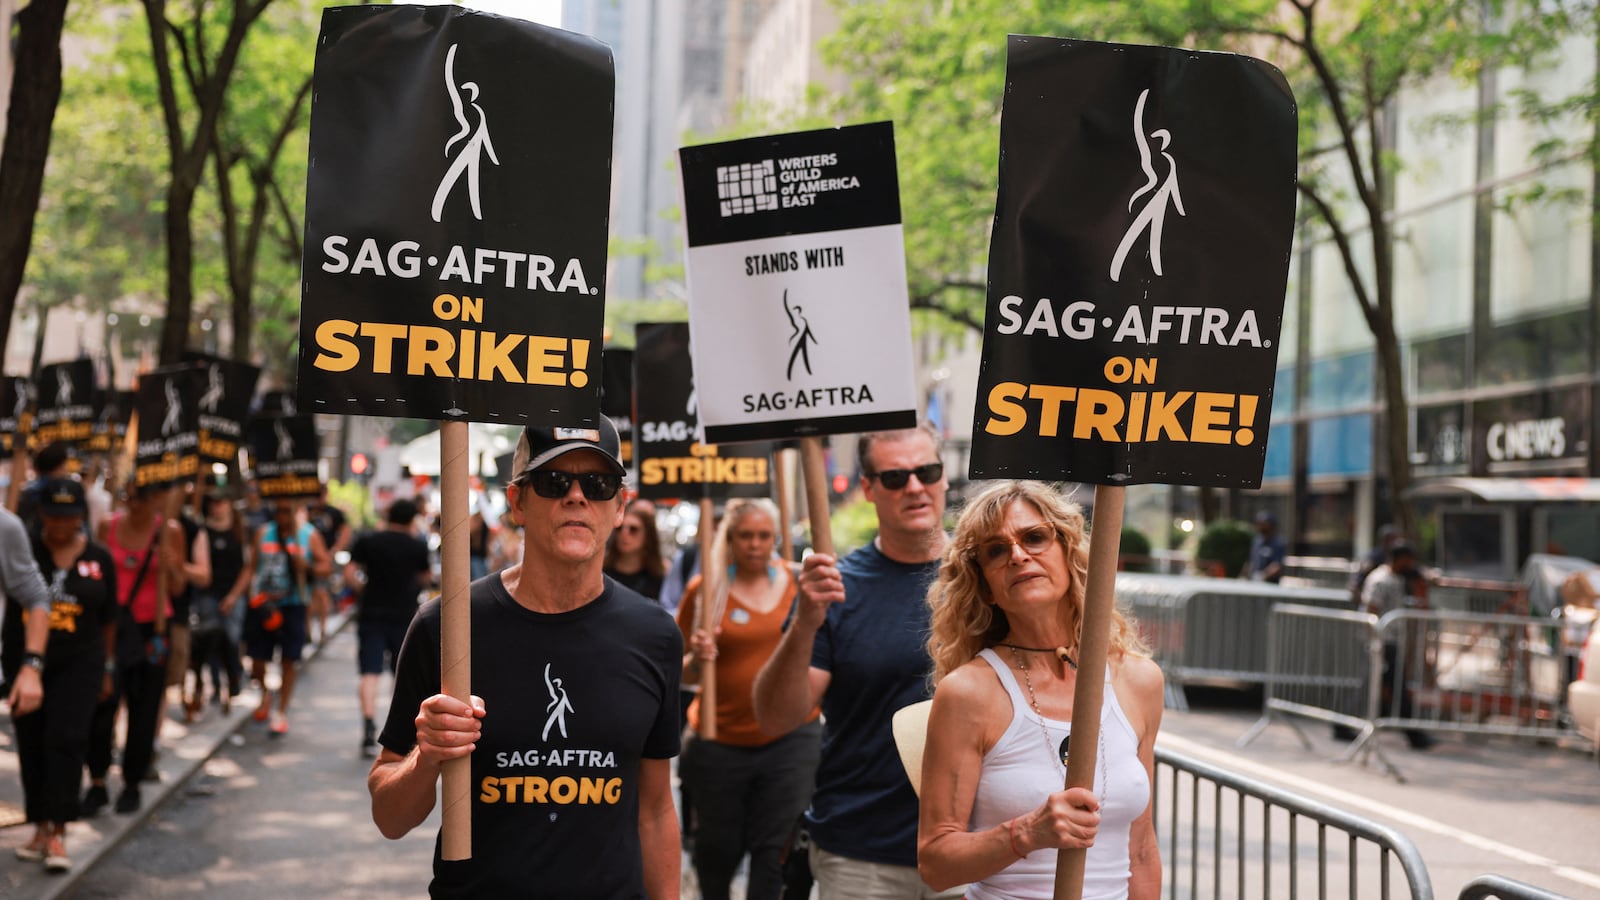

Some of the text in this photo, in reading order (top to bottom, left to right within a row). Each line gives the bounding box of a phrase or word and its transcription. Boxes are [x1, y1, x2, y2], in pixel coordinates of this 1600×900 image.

[778, 153, 837, 170] WRITERS
[780, 168, 821, 182] GUILD
[782, 176, 860, 195] of AMERICA
[782, 194, 816, 208] EAST
[745, 246, 844, 276] STANDS WITH
[432, 293, 484, 323] ON
[313, 319, 591, 389] STRIKE!
[1103, 355, 1158, 385] ON
[984, 381, 1260, 447] STRIKE!
[1505, 417, 1566, 459] NEWS
[640, 457, 769, 485] STRIKE!
[480, 775, 624, 806] STRONG
